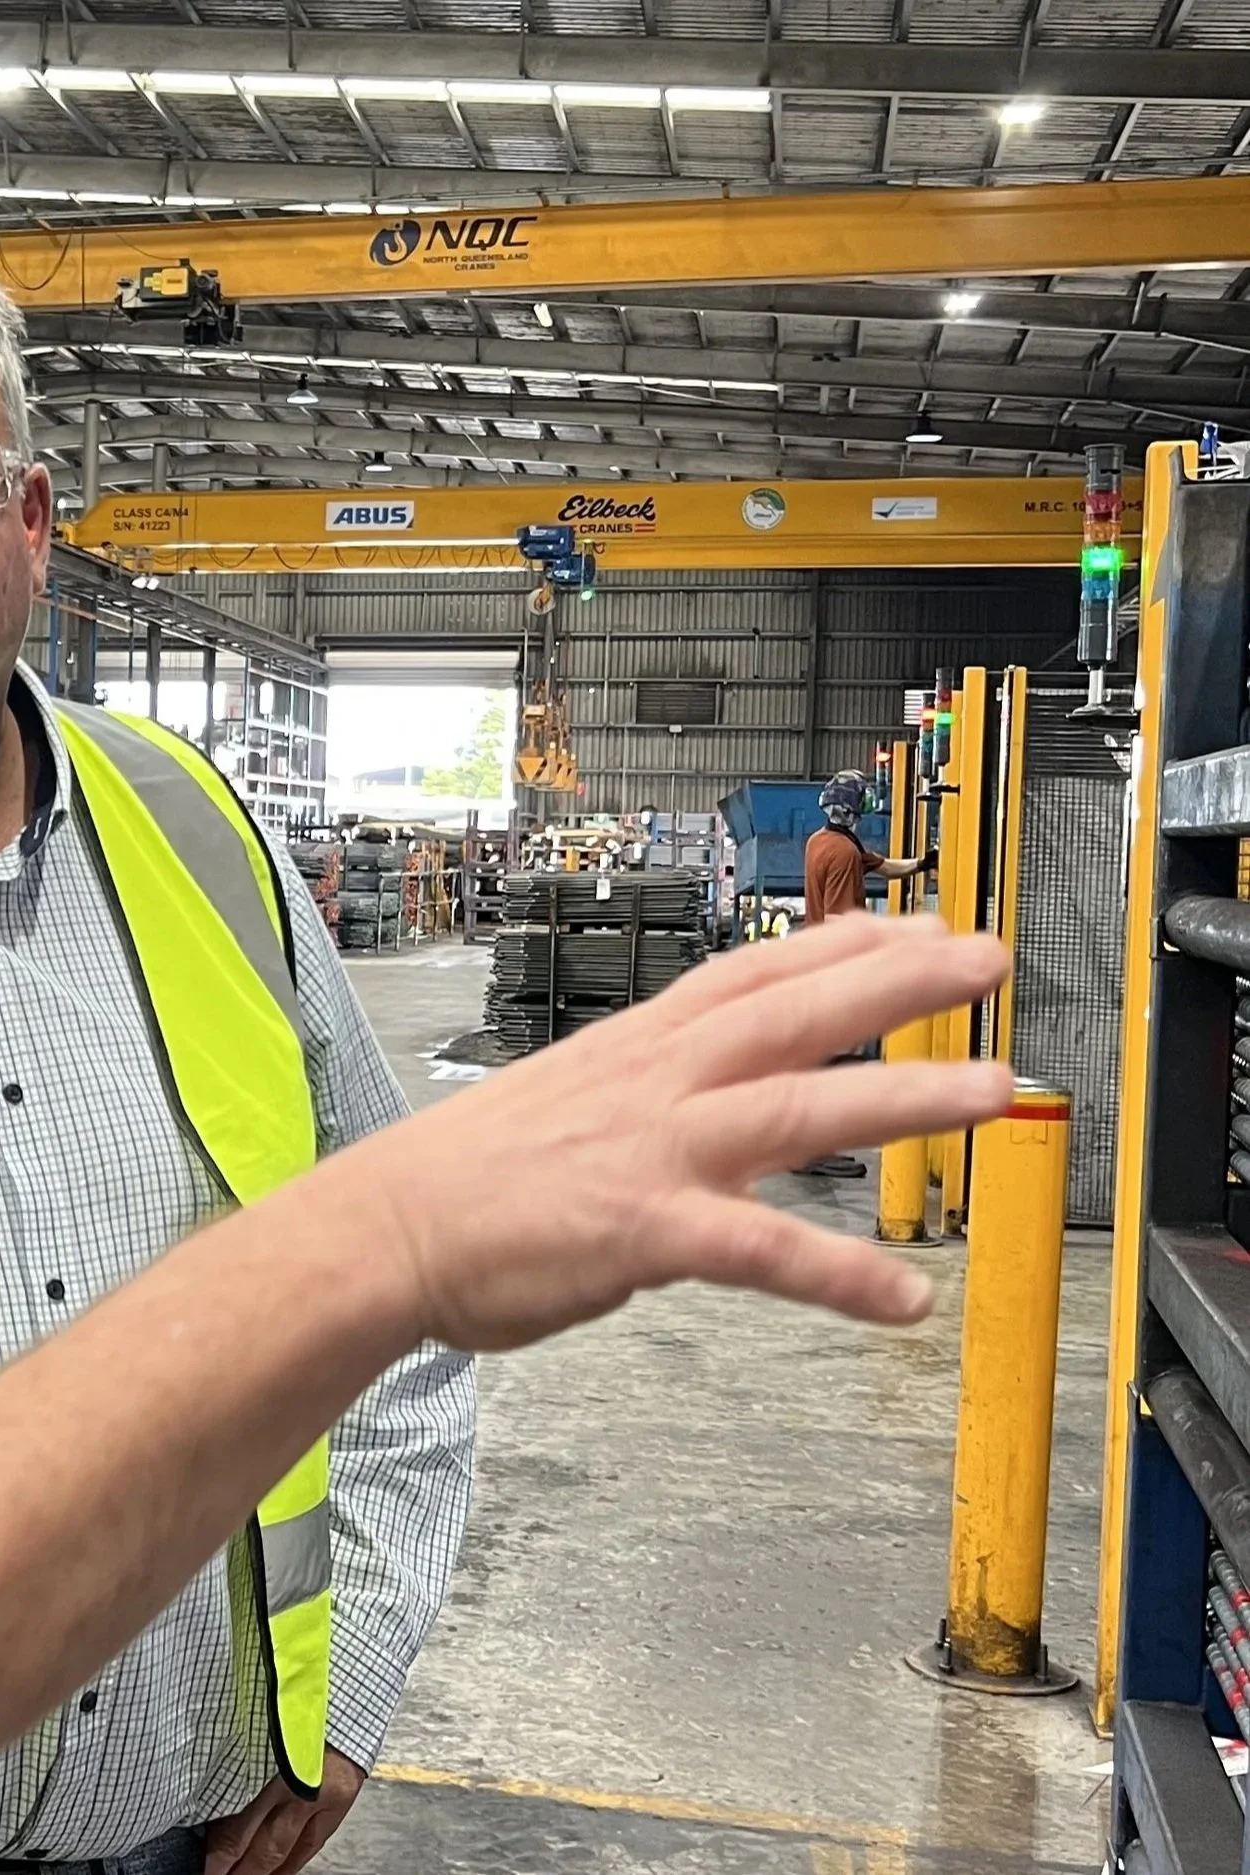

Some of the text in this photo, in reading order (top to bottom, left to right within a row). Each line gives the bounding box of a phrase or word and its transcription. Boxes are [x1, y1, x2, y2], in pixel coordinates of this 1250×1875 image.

[425, 216, 537, 250] NQC
[423, 253, 528, 264] NORTH QUEENSLAND
[454, 263, 496, 271] CRANES
[558, 495, 656, 521] Eilbeck
[1024, 501, 1067, 513] M.R.C.
[113, 508, 152, 518] CLASS
[333, 507, 407, 524] ABUS
[113, 520, 171, 531] S/N: 41223
[579, 524, 633, 534] CRANES
